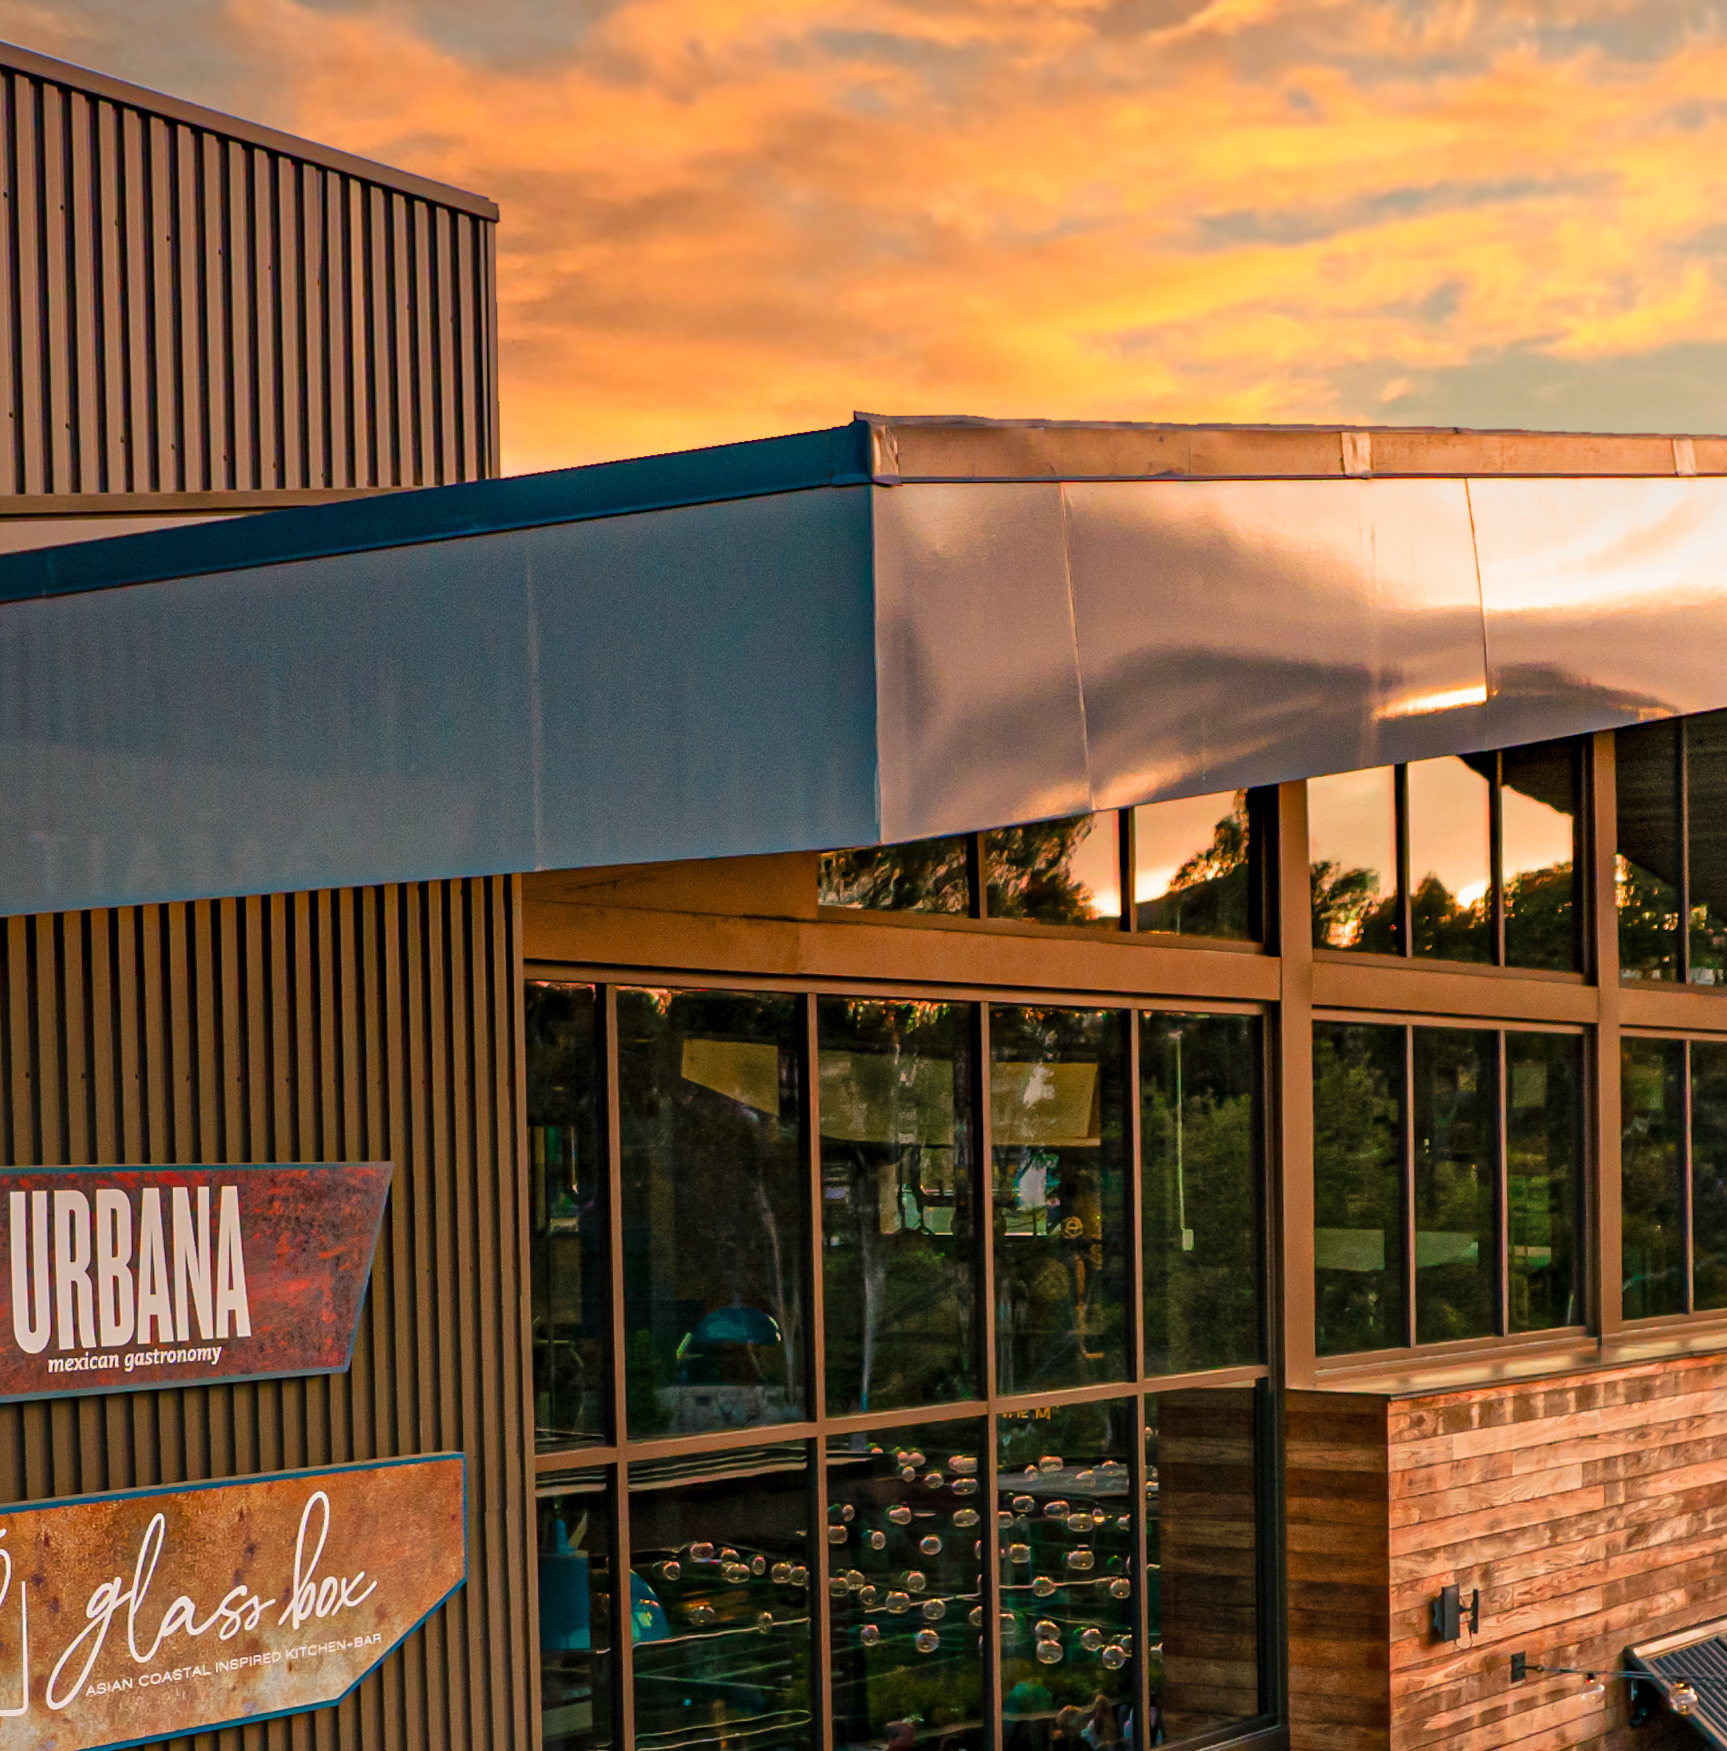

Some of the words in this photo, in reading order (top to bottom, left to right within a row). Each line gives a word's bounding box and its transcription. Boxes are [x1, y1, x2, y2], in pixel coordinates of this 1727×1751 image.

[9, 1185, 251, 1355] URBANA
[47, 1351, 120, 1374] mexican
[123, 1344, 223, 1373] gastronomy
[46, 1512, 276, 1711] glass
[278, 1490, 378, 1631] box
[84, 1677, 134, 1697] ASIAN
[138, 1663, 212, 1688] COASTAL
[214, 1651, 282, 1674] INSPIRED
